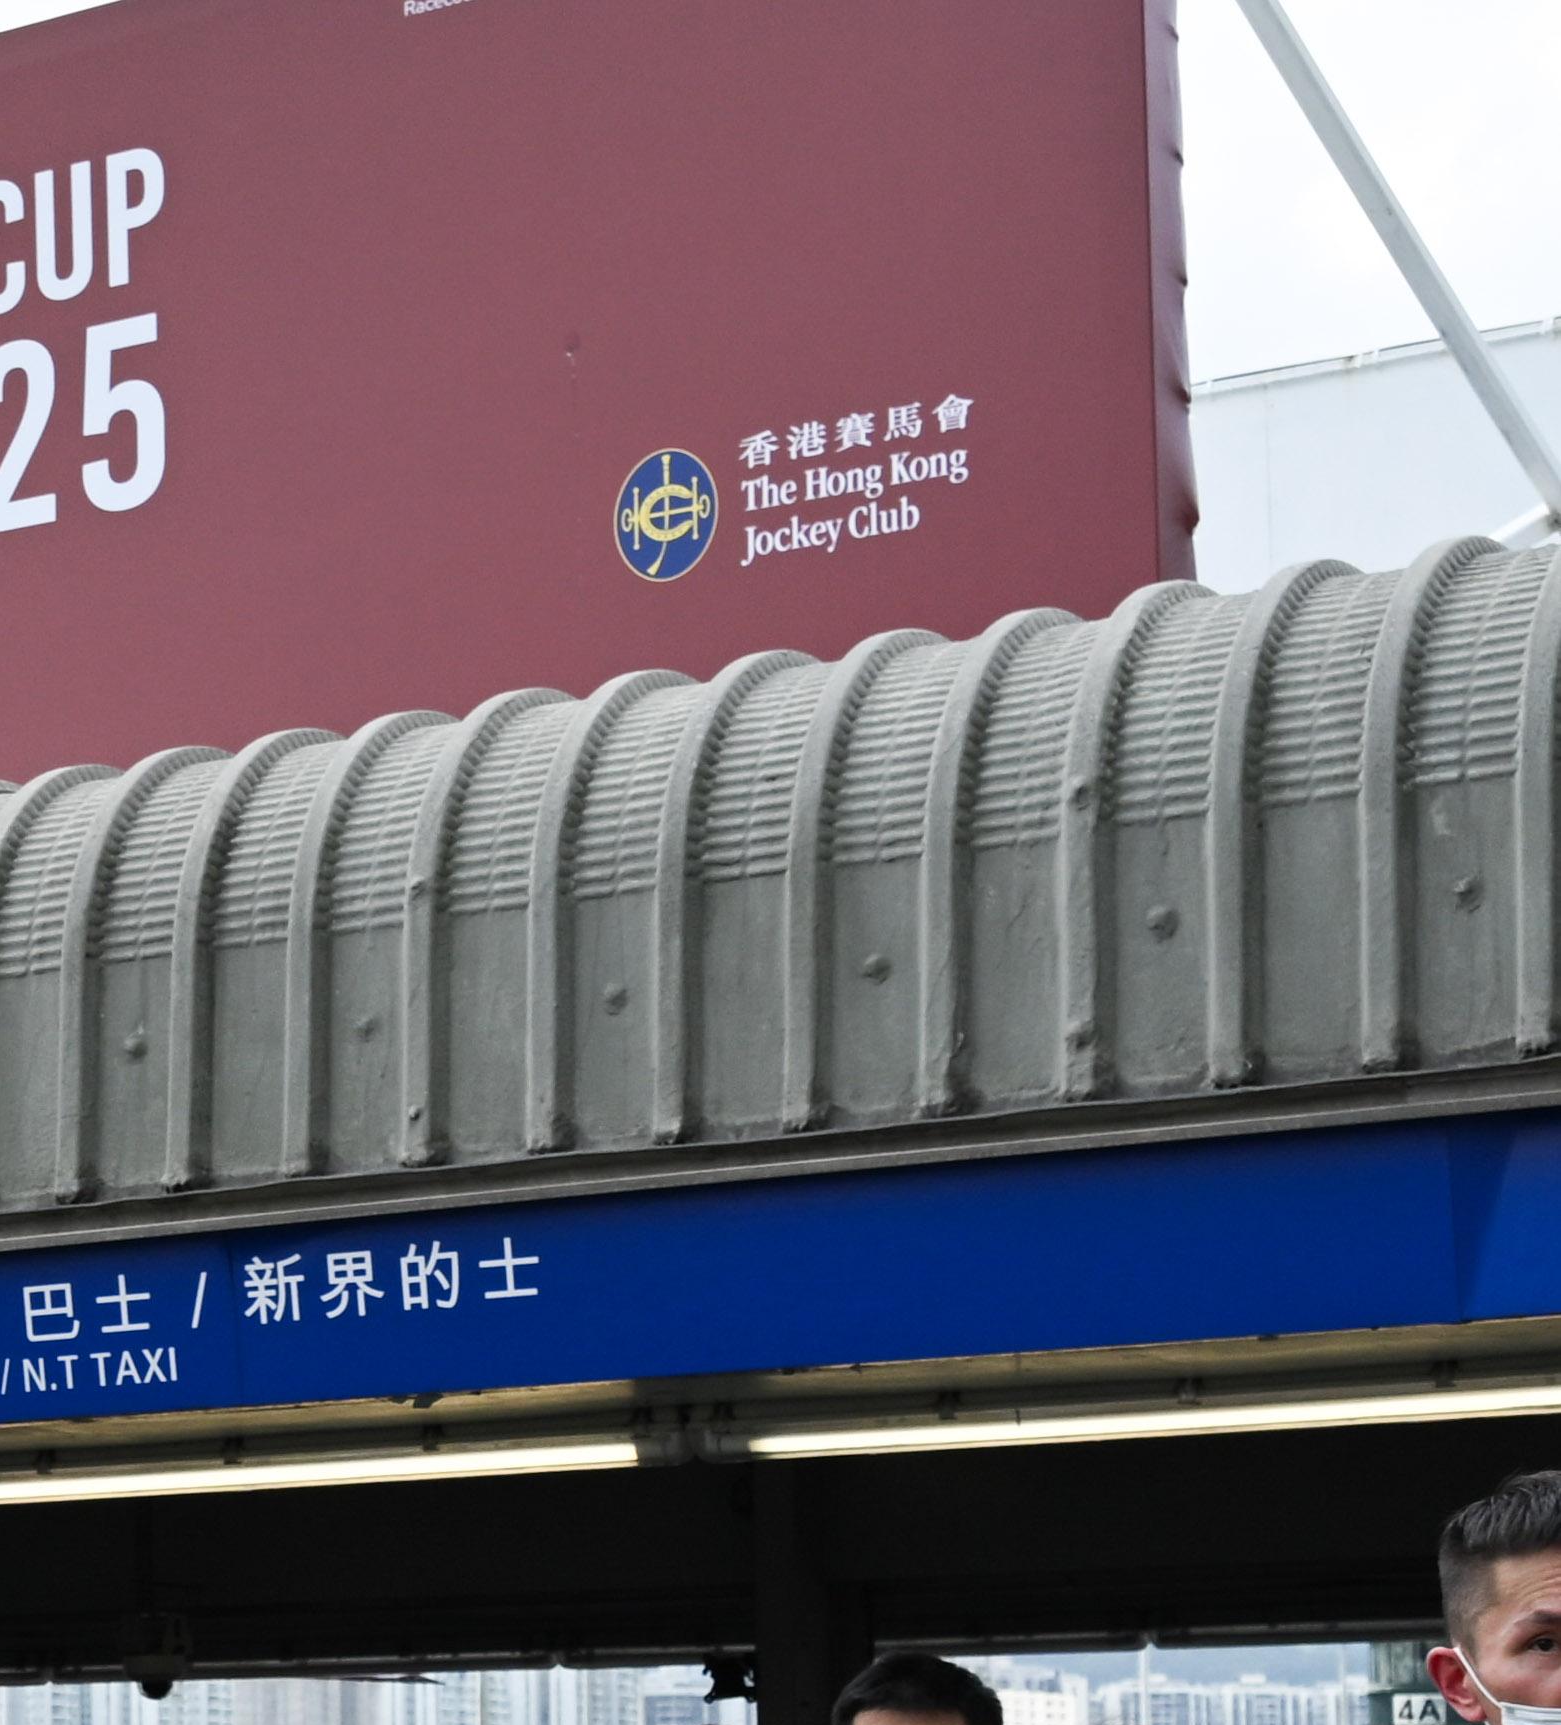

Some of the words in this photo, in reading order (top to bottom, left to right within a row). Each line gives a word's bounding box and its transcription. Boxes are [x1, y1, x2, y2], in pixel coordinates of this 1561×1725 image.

[739, 393, 973, 470] 香港賽馬會
[741, 476, 797, 511] The
[804, 463, 883, 499] Hong
[890, 445, 968, 485] Kong
[740, 515, 843, 566] Jockey
[848, 496, 920, 539] Club
[23, 1275, 152, 1343] 巴士
[243, 1236, 541, 1326] 新界的士
[22, 1355, 79, 1393] N.T
[89, 1347, 178, 1388] TAXI
[1399, 1700, 1440, 1720] 4A
